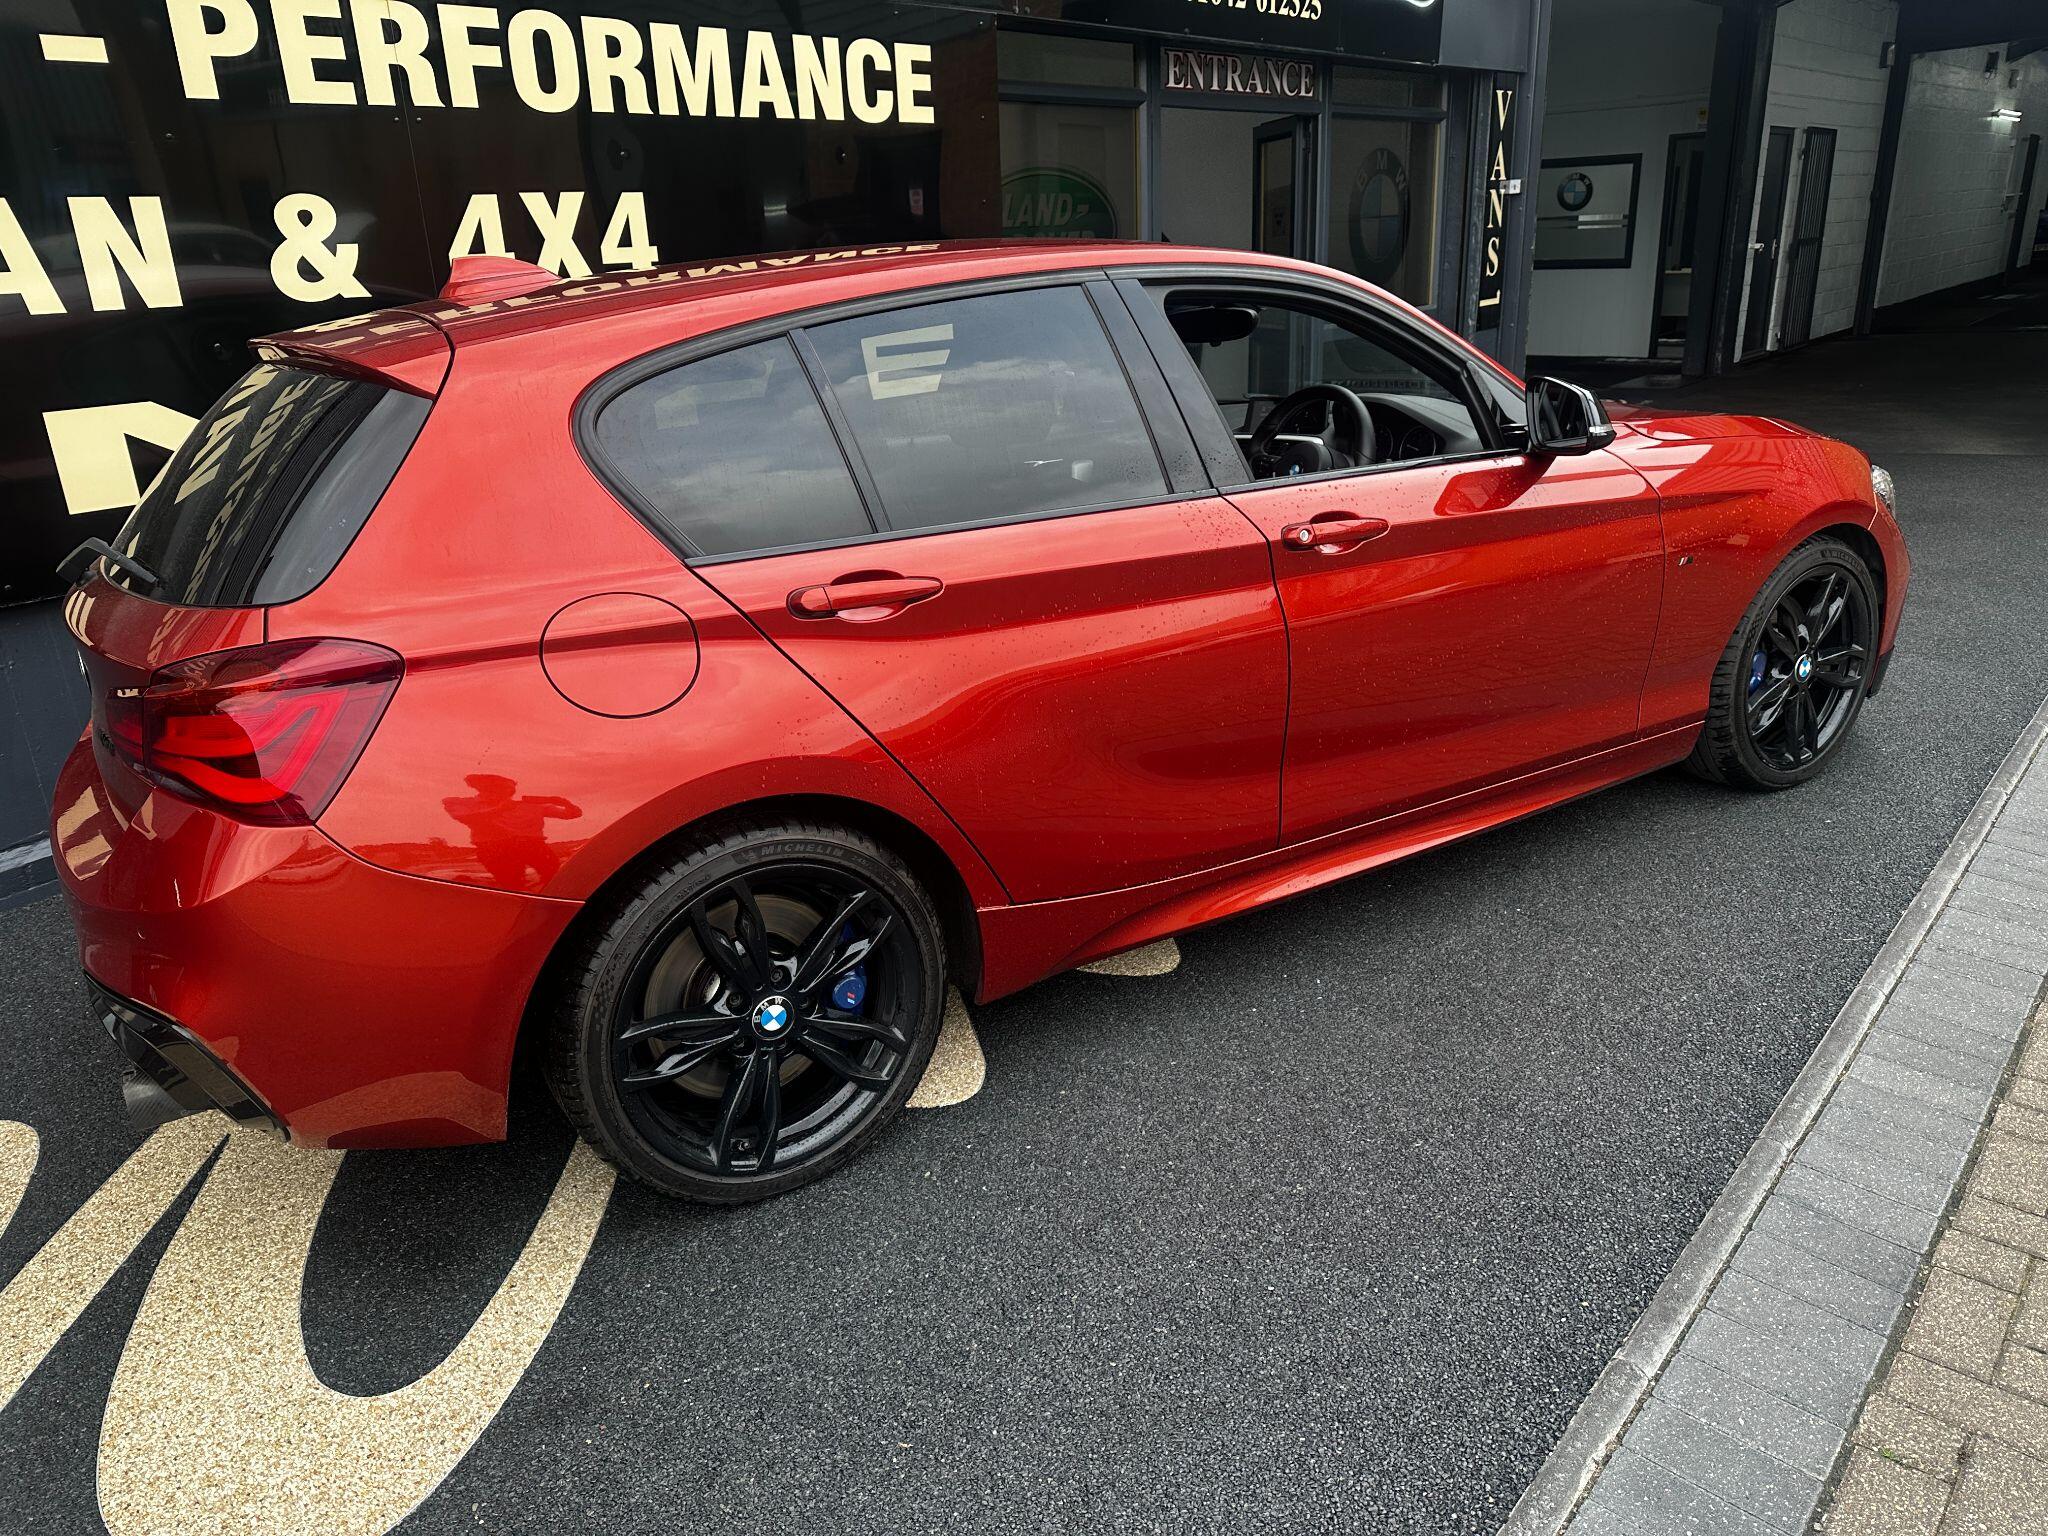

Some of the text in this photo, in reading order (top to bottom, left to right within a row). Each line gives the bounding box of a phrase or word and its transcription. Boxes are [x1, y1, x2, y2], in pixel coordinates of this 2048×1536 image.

[165, 0, 935, 124] PERFORMANCE
[1164, 50, 1314, 97] ENTRANCE
[270, 192, 372, 302] &
[448, 191, 659, 278] 4X4
[761, 843, 844, 857] MICHELIN
